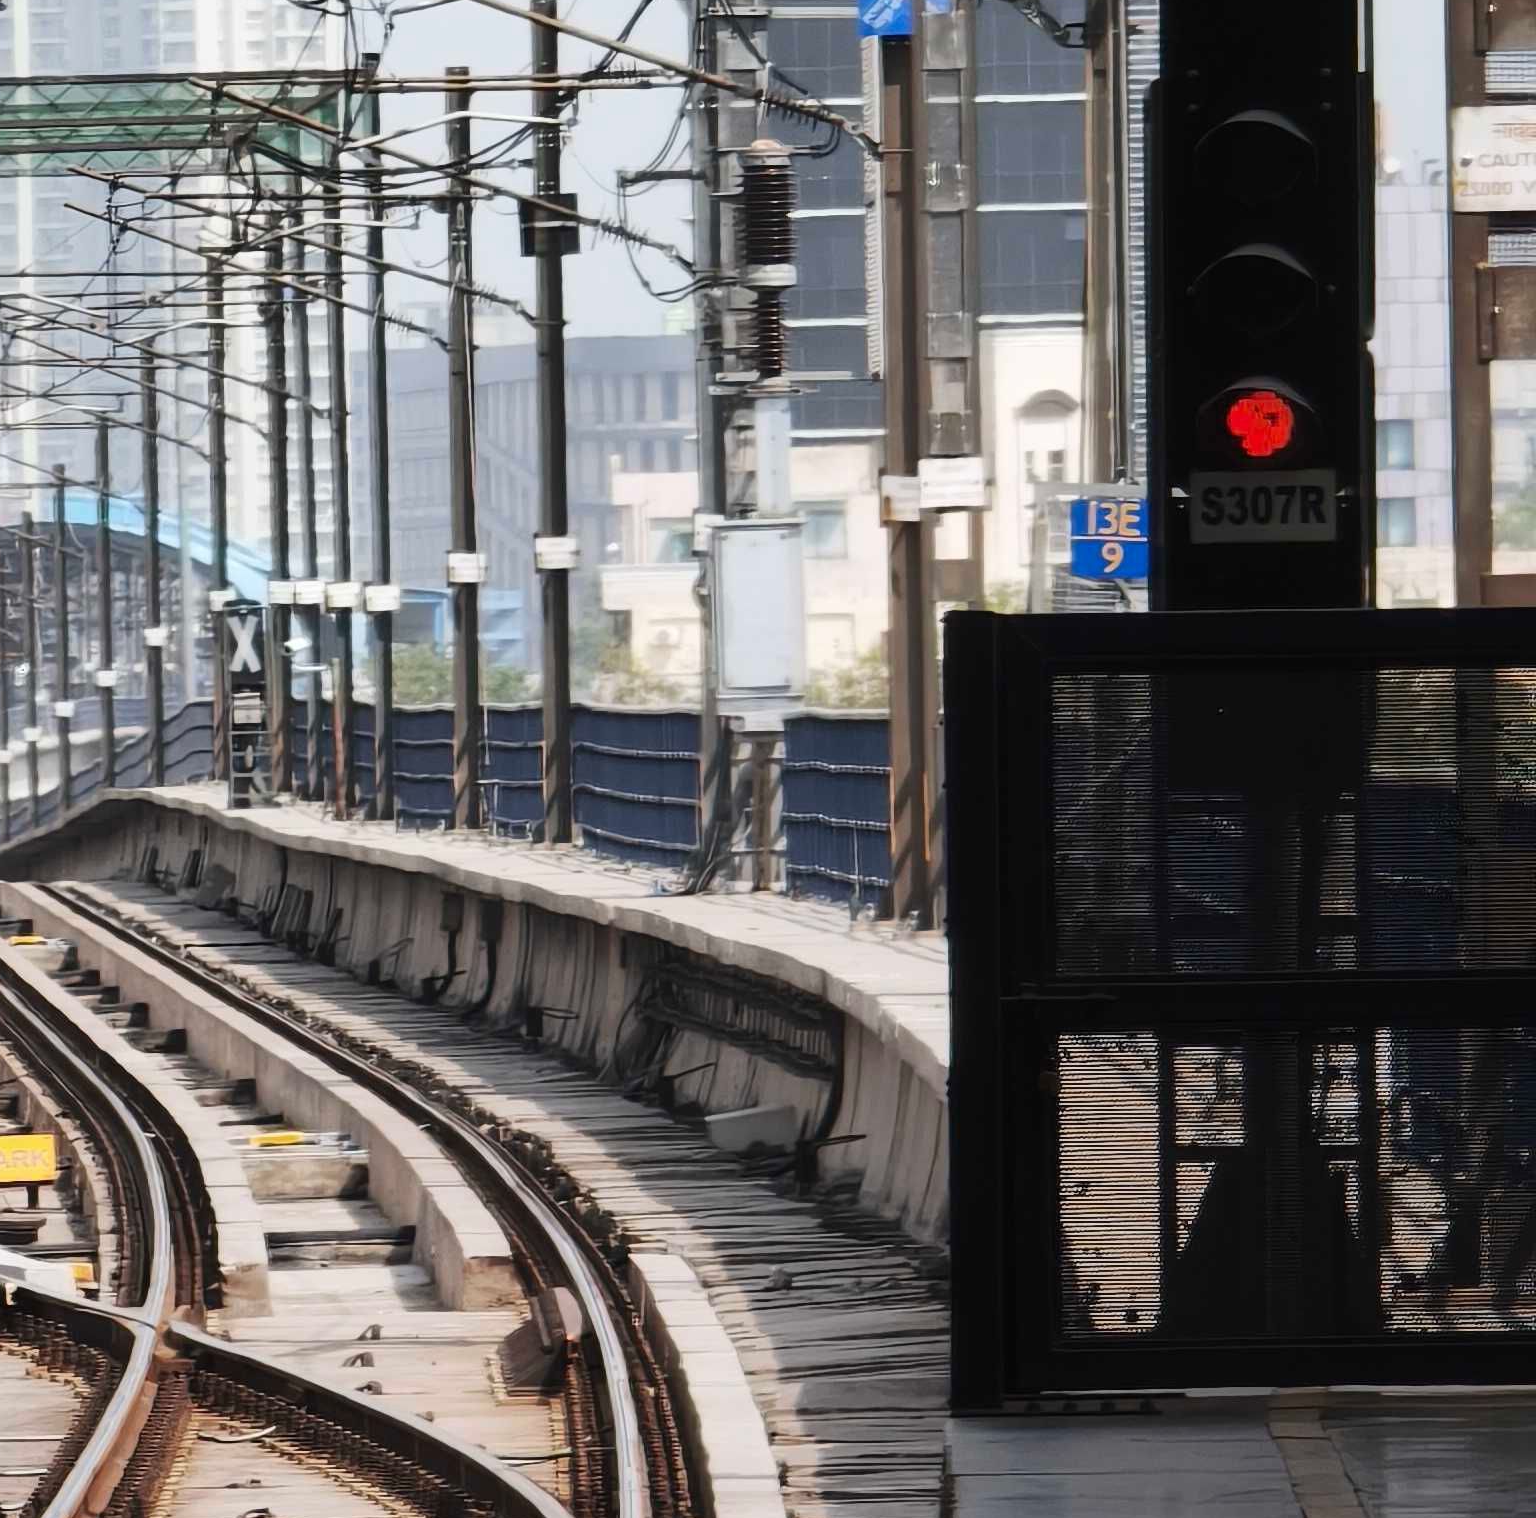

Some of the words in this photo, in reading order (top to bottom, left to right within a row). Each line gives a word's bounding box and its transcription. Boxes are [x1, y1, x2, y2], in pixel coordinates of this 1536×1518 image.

[1087, 500, 1141, 536] 13E
[1200, 485, 1327, 526] S307R
[1100, 541, 1125, 574] 9
